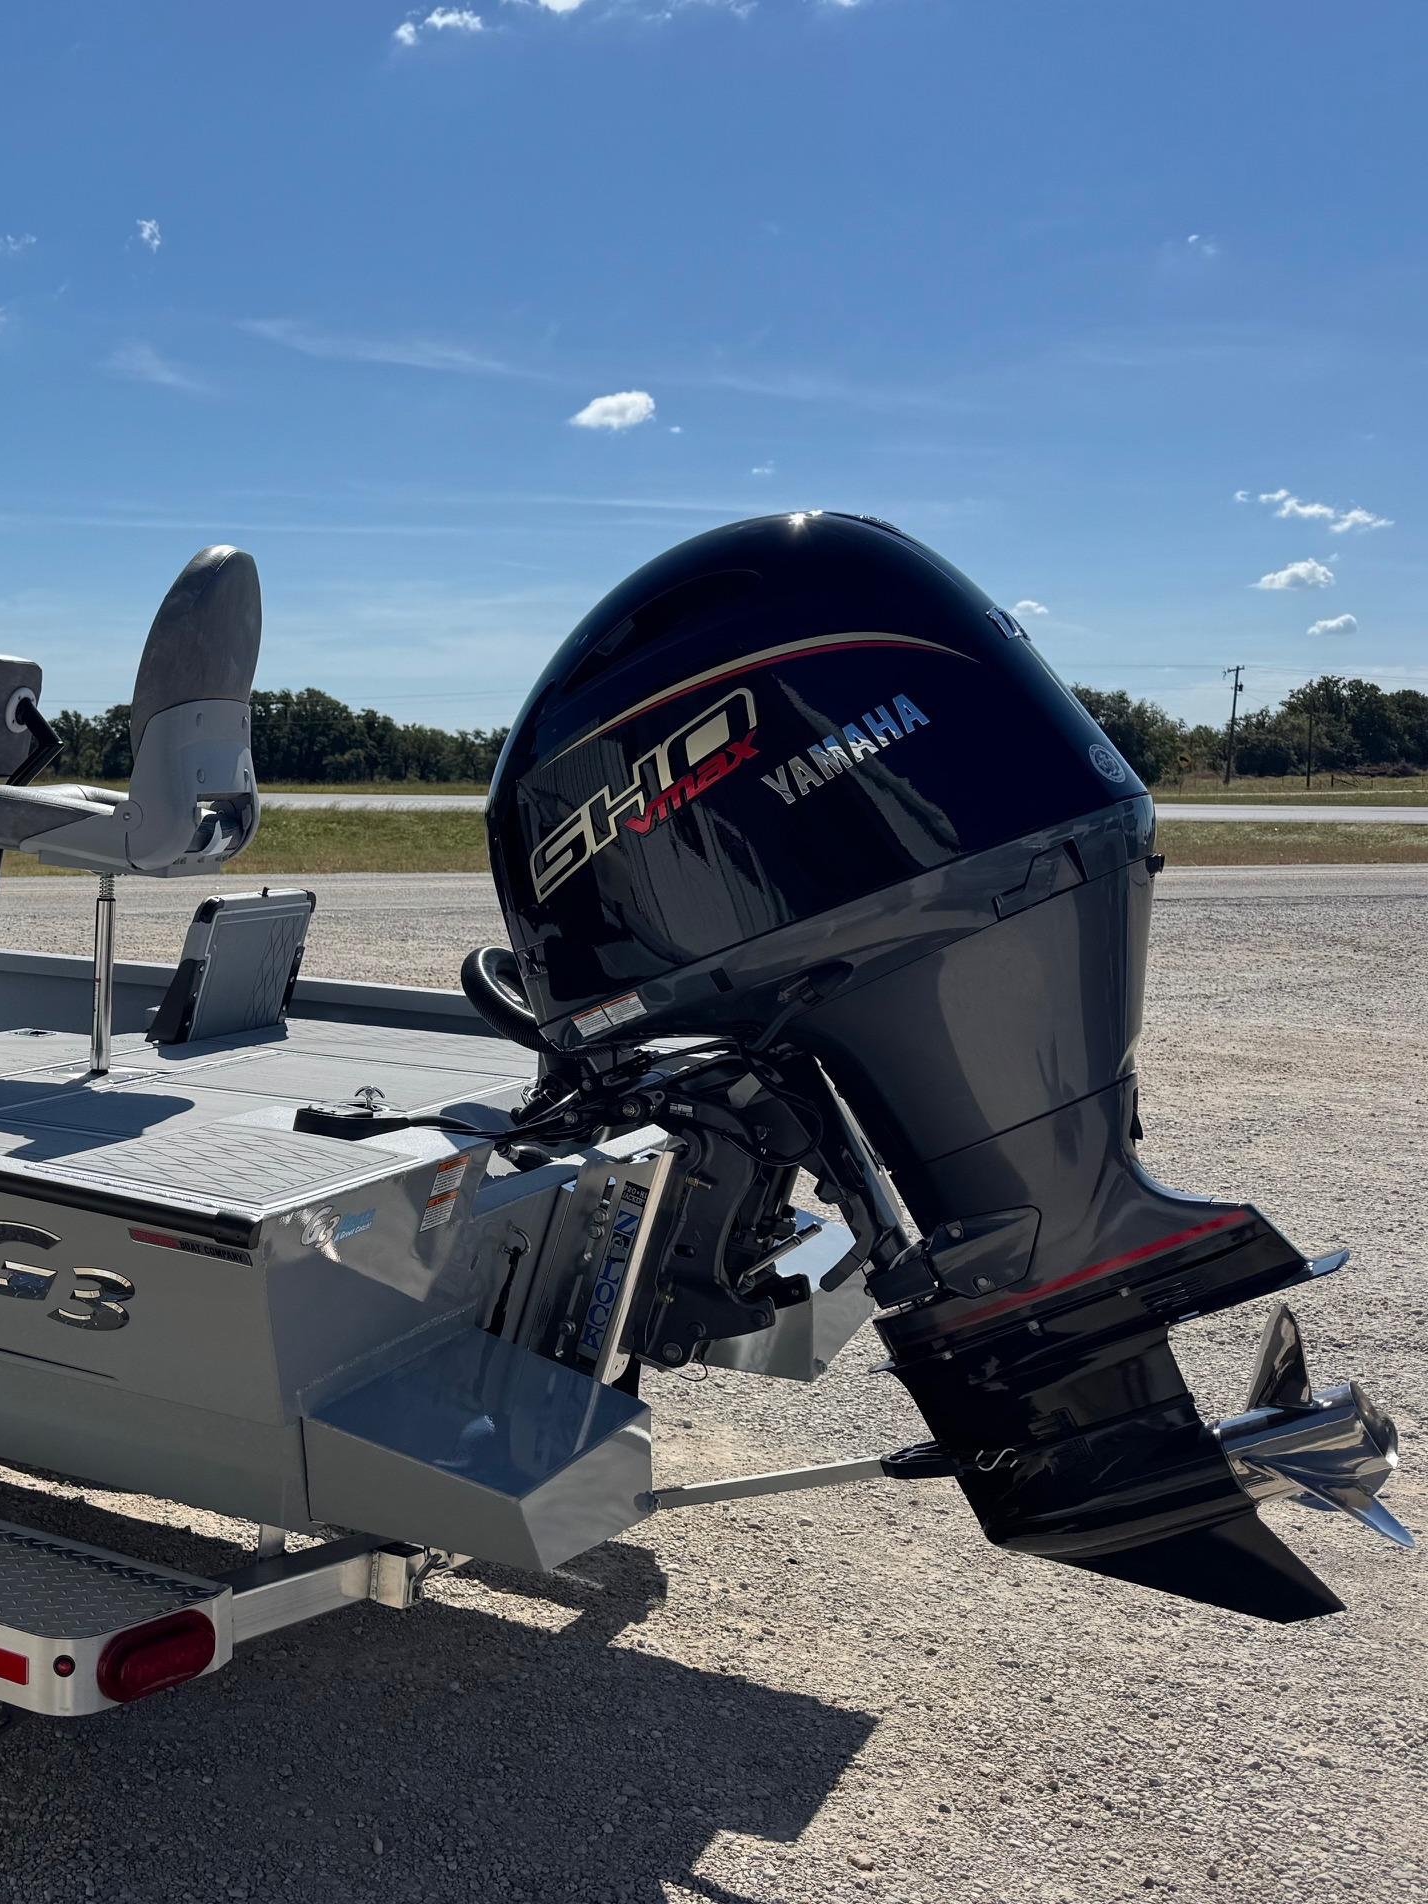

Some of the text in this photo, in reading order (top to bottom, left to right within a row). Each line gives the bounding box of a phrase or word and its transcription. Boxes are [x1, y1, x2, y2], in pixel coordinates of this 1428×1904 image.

[761, 693, 930, 804] YAMAHA
[179, 1239, 244, 1263] BOAT COMPANY
